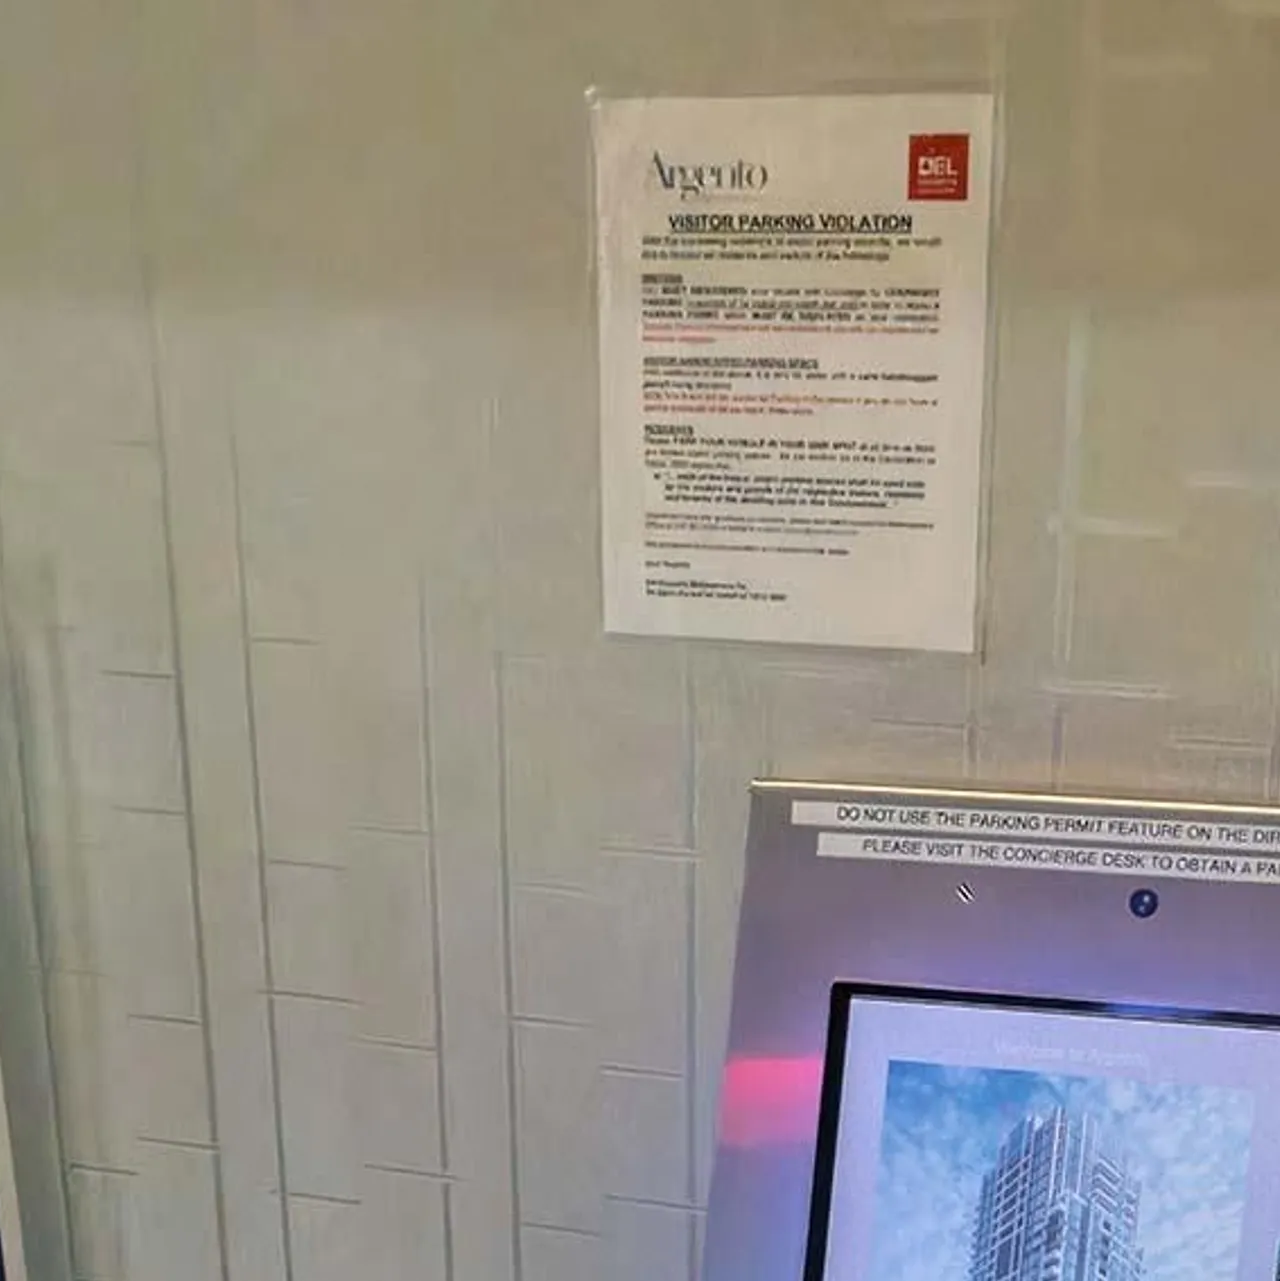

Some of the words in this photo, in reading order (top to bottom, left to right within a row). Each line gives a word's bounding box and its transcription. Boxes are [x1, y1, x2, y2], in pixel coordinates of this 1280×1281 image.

[652, 149, 769, 199] Argento
[668, 214, 735, 231] VISITOR
[738, 214, 815, 231] PARKING
[819, 214, 913, 232] VIOLATION
[836, 806, 859, 822] DO
[864, 808, 895, 824] NOT
[899, 809, 930, 825] USE
[936, 811, 966, 827] THE
[969, 813, 1041, 831] PARKING
[1044, 816, 1103, 833] PERMIT
[1107, 818, 1182, 839] FEATURE
[1186, 824, 1212, 841] ON
[1217, 826, 1250, 844] THE
[862, 838, 922, 856] PLEASE
[926, 841, 964, 857] VISIT
[969, 844, 1000, 860] THE
[1002, 846, 1098, 865] CONCIERGE
[1102, 851, 1145, 869] DESK
[1152, 854, 1173, 870] TO
[1175, 857, 1237, 875] OBTAIN
[1239, 860, 1253, 875] A
